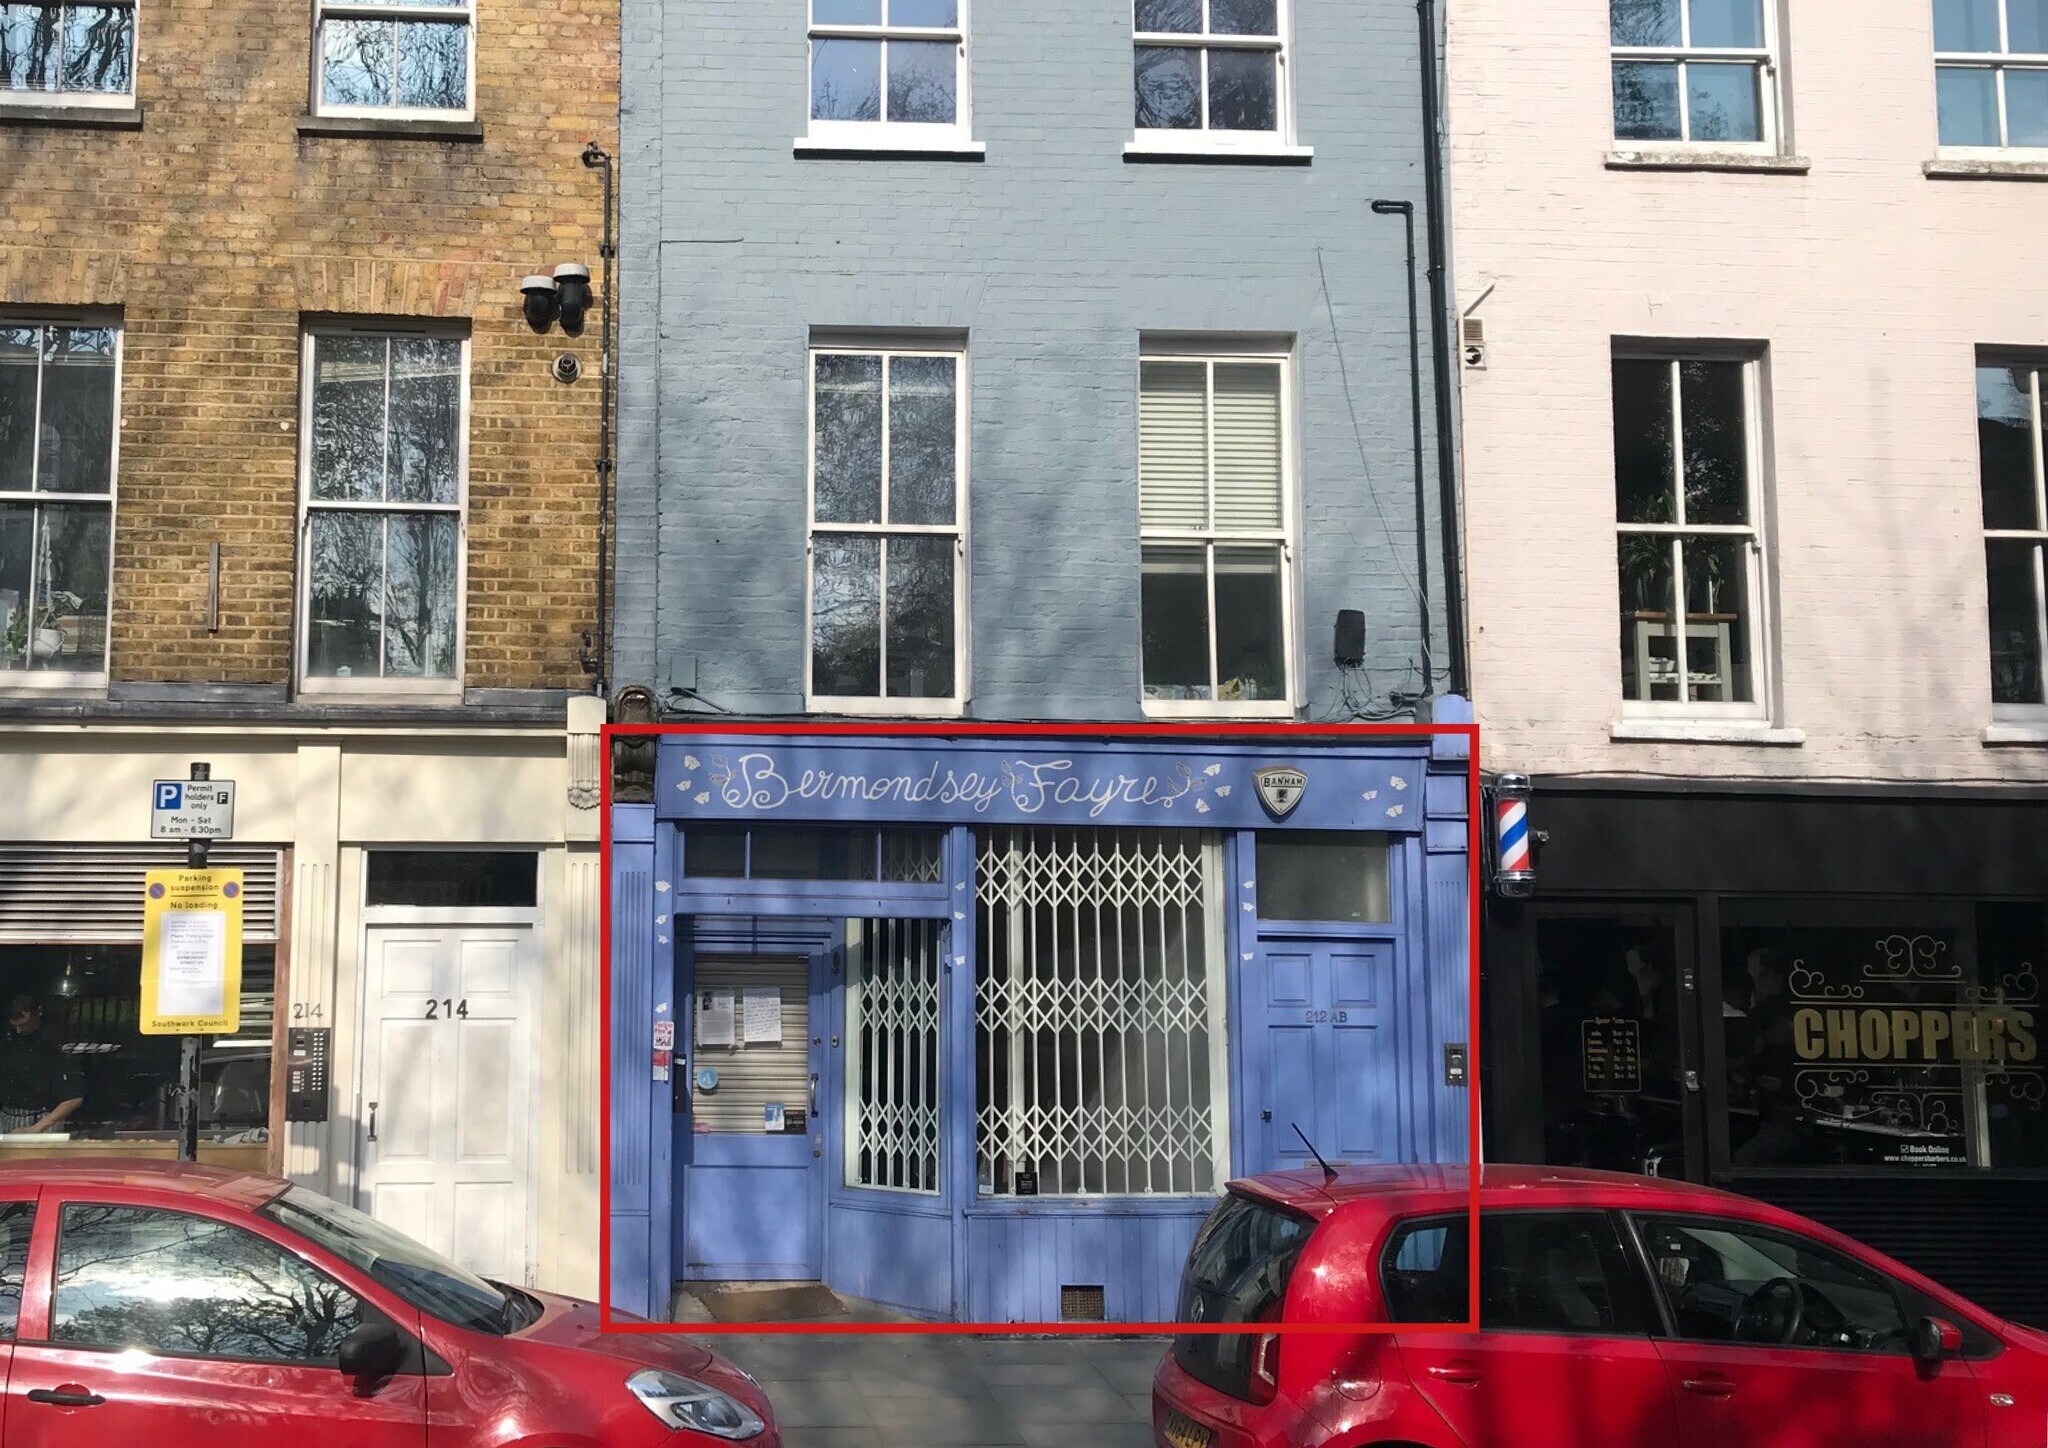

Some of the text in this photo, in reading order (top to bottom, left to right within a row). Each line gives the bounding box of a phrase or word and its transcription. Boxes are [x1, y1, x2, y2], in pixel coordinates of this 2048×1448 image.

[721, 753, 1166, 818] Bermondsey Fayre
[1264, 776, 1303, 788] BANHAM
[187, 784, 213, 792] Permit
[160, 785, 178, 808] P
[184, 793, 214, 801] holders
[190, 802, 208, 810] only
[197, 816, 212, 824] Sat
[160, 825, 166, 833] 8
[179, 874, 212, 883] Parking
[170, 883, 219, 892] suspension
[170, 901, 219, 910] No loading
[292, 1002, 323, 1019] 214
[424, 998, 469, 1020] 214
[1305, 1010, 1348, 1023] 212 AB
[151, 1018, 229, 1028] Southwark Council
[1793, 1008, 2038, 1062] CHOPPERS
[1909, 1144, 1950, 1154] Book Online
